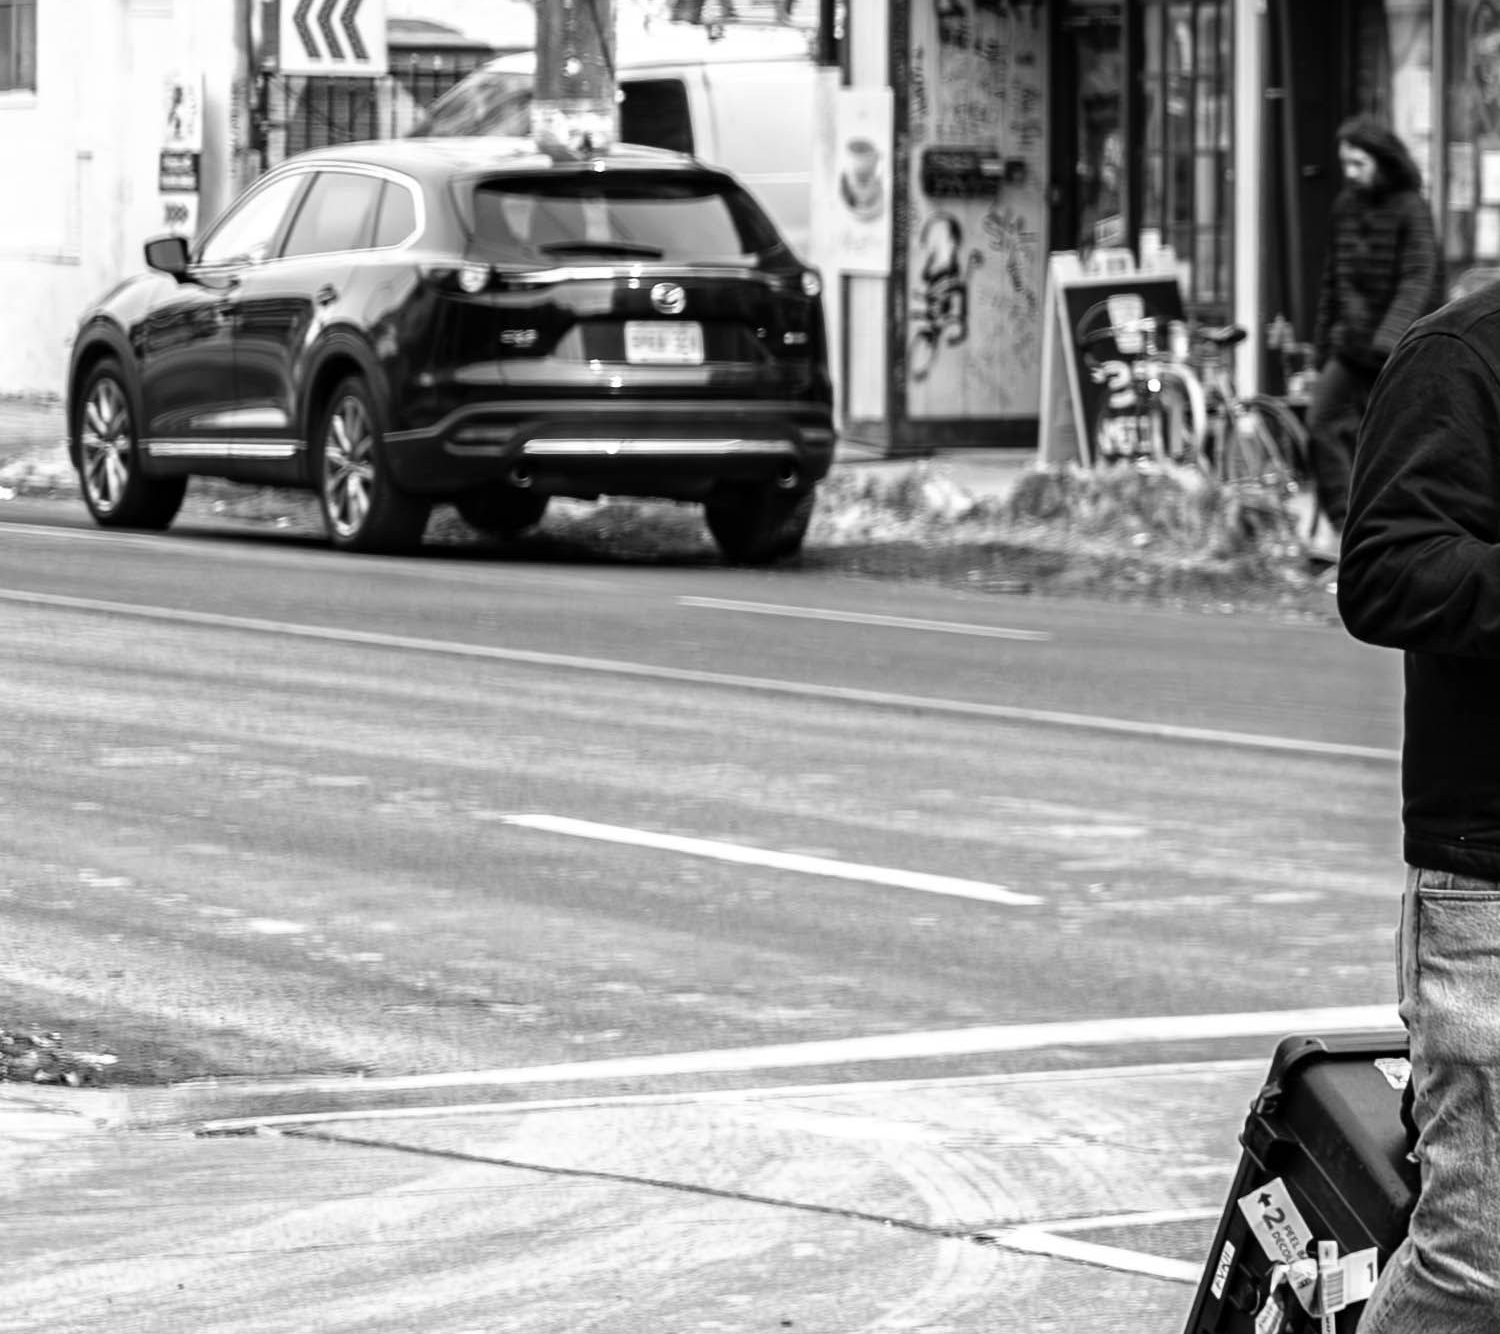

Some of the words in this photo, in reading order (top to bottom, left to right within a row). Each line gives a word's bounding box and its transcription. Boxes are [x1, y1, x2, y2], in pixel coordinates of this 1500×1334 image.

[1263, 1207, 1286, 1231] 2
[1284, 1225, 1300, 1254] PEEL
[1365, 1261, 1375, 1283] 1
